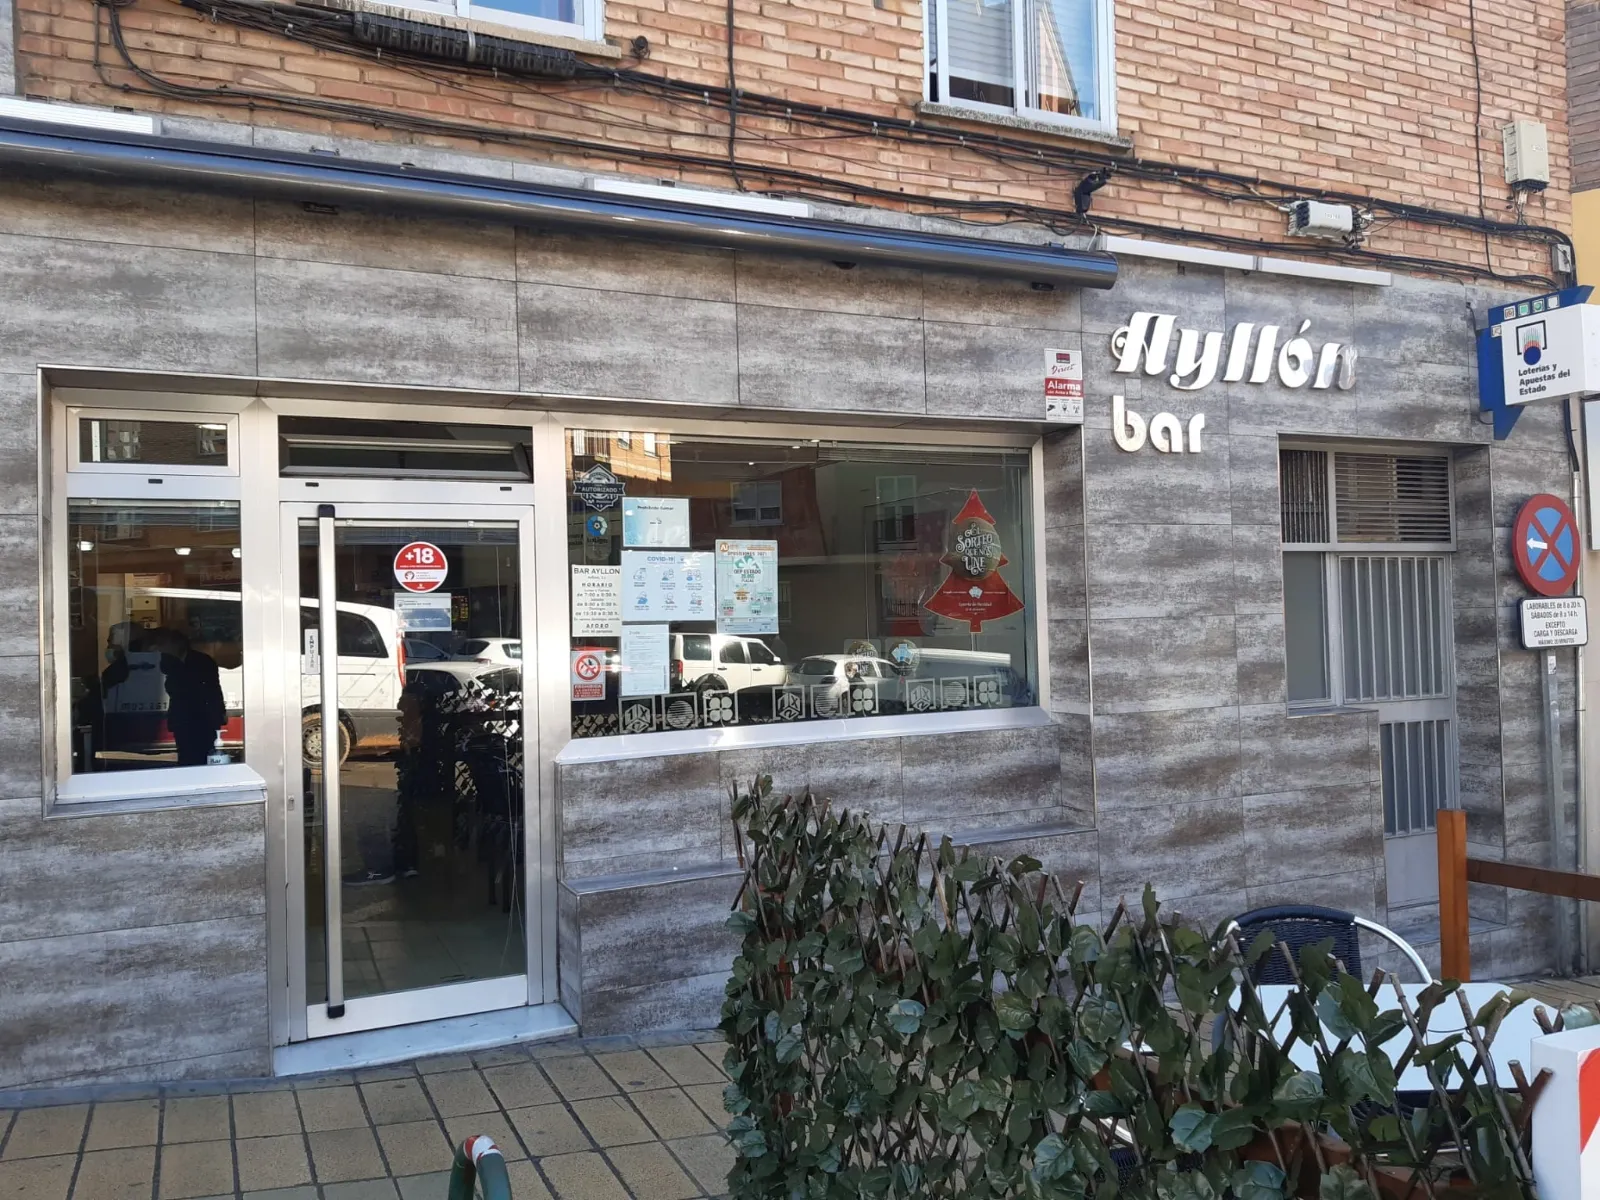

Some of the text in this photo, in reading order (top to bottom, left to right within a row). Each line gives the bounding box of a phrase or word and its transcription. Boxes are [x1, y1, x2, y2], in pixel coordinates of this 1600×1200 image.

[1111, 311, 1358, 390] Ayllón
[1518, 363, 1557, 377] Loterías y
[1520, 369, 1570, 386] Apuestas del
[1047, 380, 1081, 391] Alarma
[1519, 384, 1547, 396] Estado
[1112, 395, 1205, 453] bar
[956, 533, 992, 552] SORTEO
[404, 547, 434, 564] +18
[964, 545, 992, 558] QUE NOS
[962, 555, 986, 576] UNE
[1526, 601, 1556, 610] LABORABLES
[1530, 611, 1552, 619] SÁBADOS
